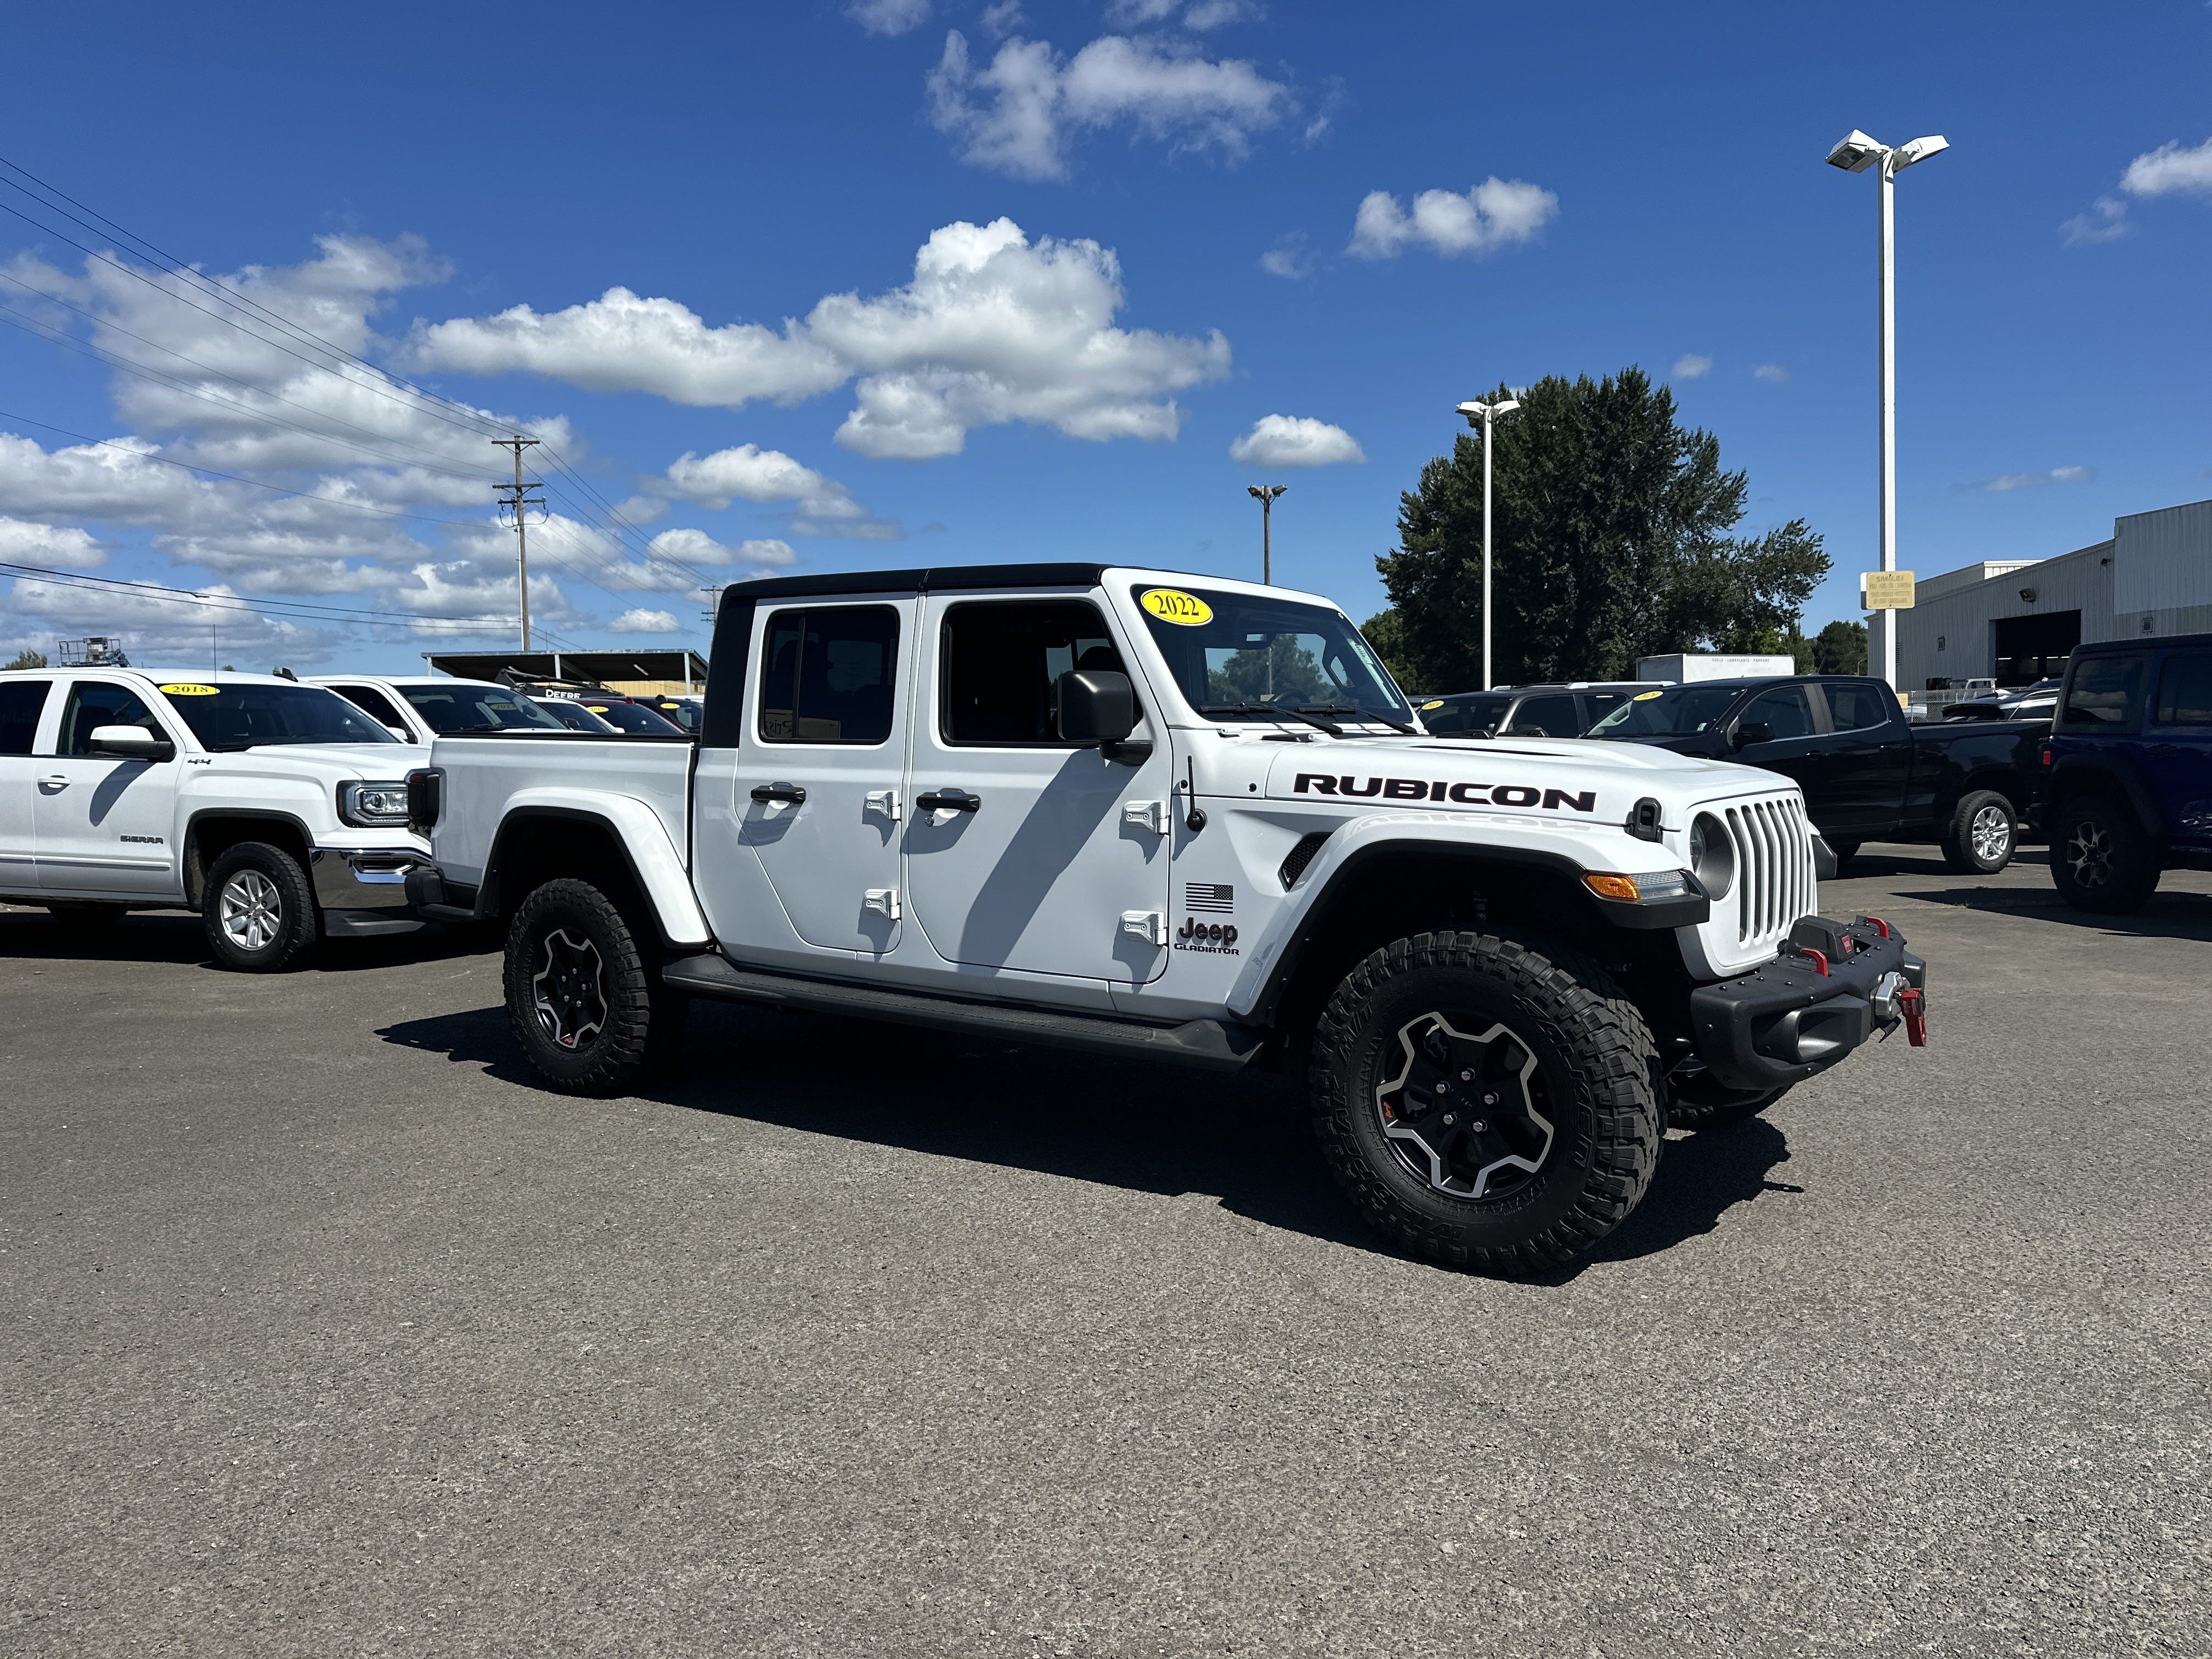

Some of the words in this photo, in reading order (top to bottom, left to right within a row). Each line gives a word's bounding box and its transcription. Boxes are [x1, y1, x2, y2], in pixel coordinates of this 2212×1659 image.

[1154, 595, 1199, 616] 2022
[545, 689, 581, 699] DEERE
[1293, 773, 1597, 812] RUBICON
[120, 835, 163, 844] SIERRA
[1178, 917, 1238, 945] Jeep
[1174, 943, 1240, 956] GLADIATOR
